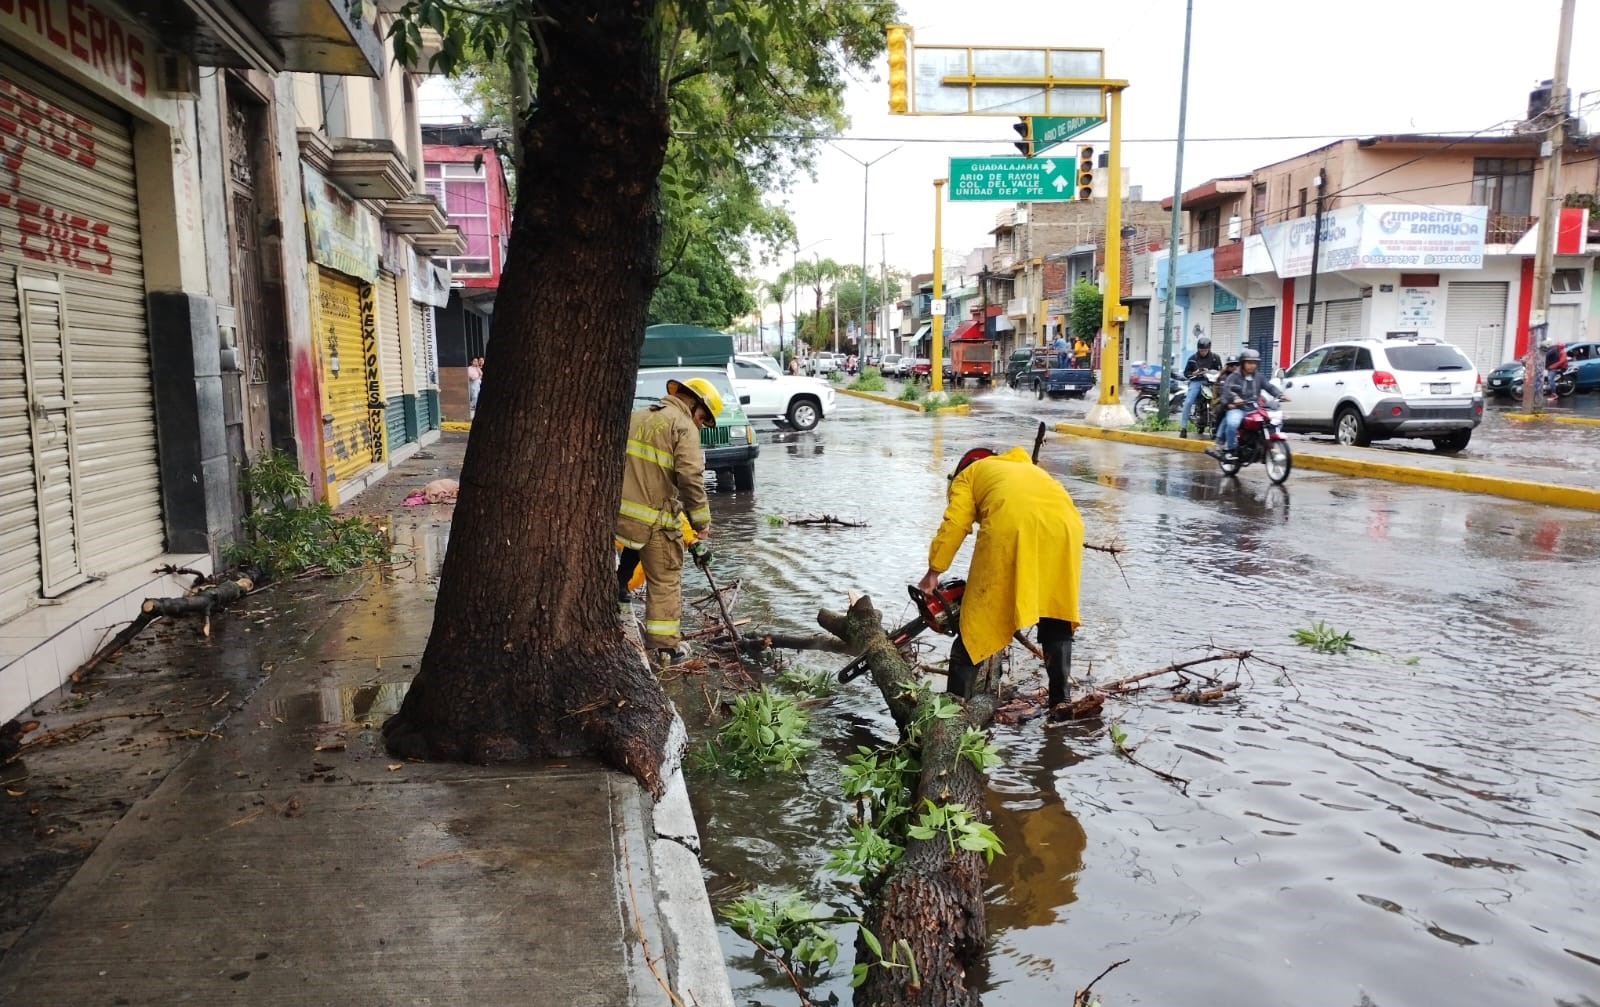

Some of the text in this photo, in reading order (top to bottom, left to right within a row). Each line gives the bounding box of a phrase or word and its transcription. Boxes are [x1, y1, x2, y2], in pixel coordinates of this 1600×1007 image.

[1057, 122, 1066, 137] DE
[971, 163, 1039, 171] GUADALAJARA
[960, 173, 1040, 181] ARIO DE RAYON
[959, 181, 982, 189] COL.
[1011, 180, 1040, 188] VALLE
[956, 188, 993, 196] UNIDAD
[1026, 187, 1044, 195] PTE
[1392, 211, 1462, 223] IMPRENTA
[1410, 223, 1479, 236] ZAMAYOA
[424, 306, 434, 372] COMPUTADORAS
